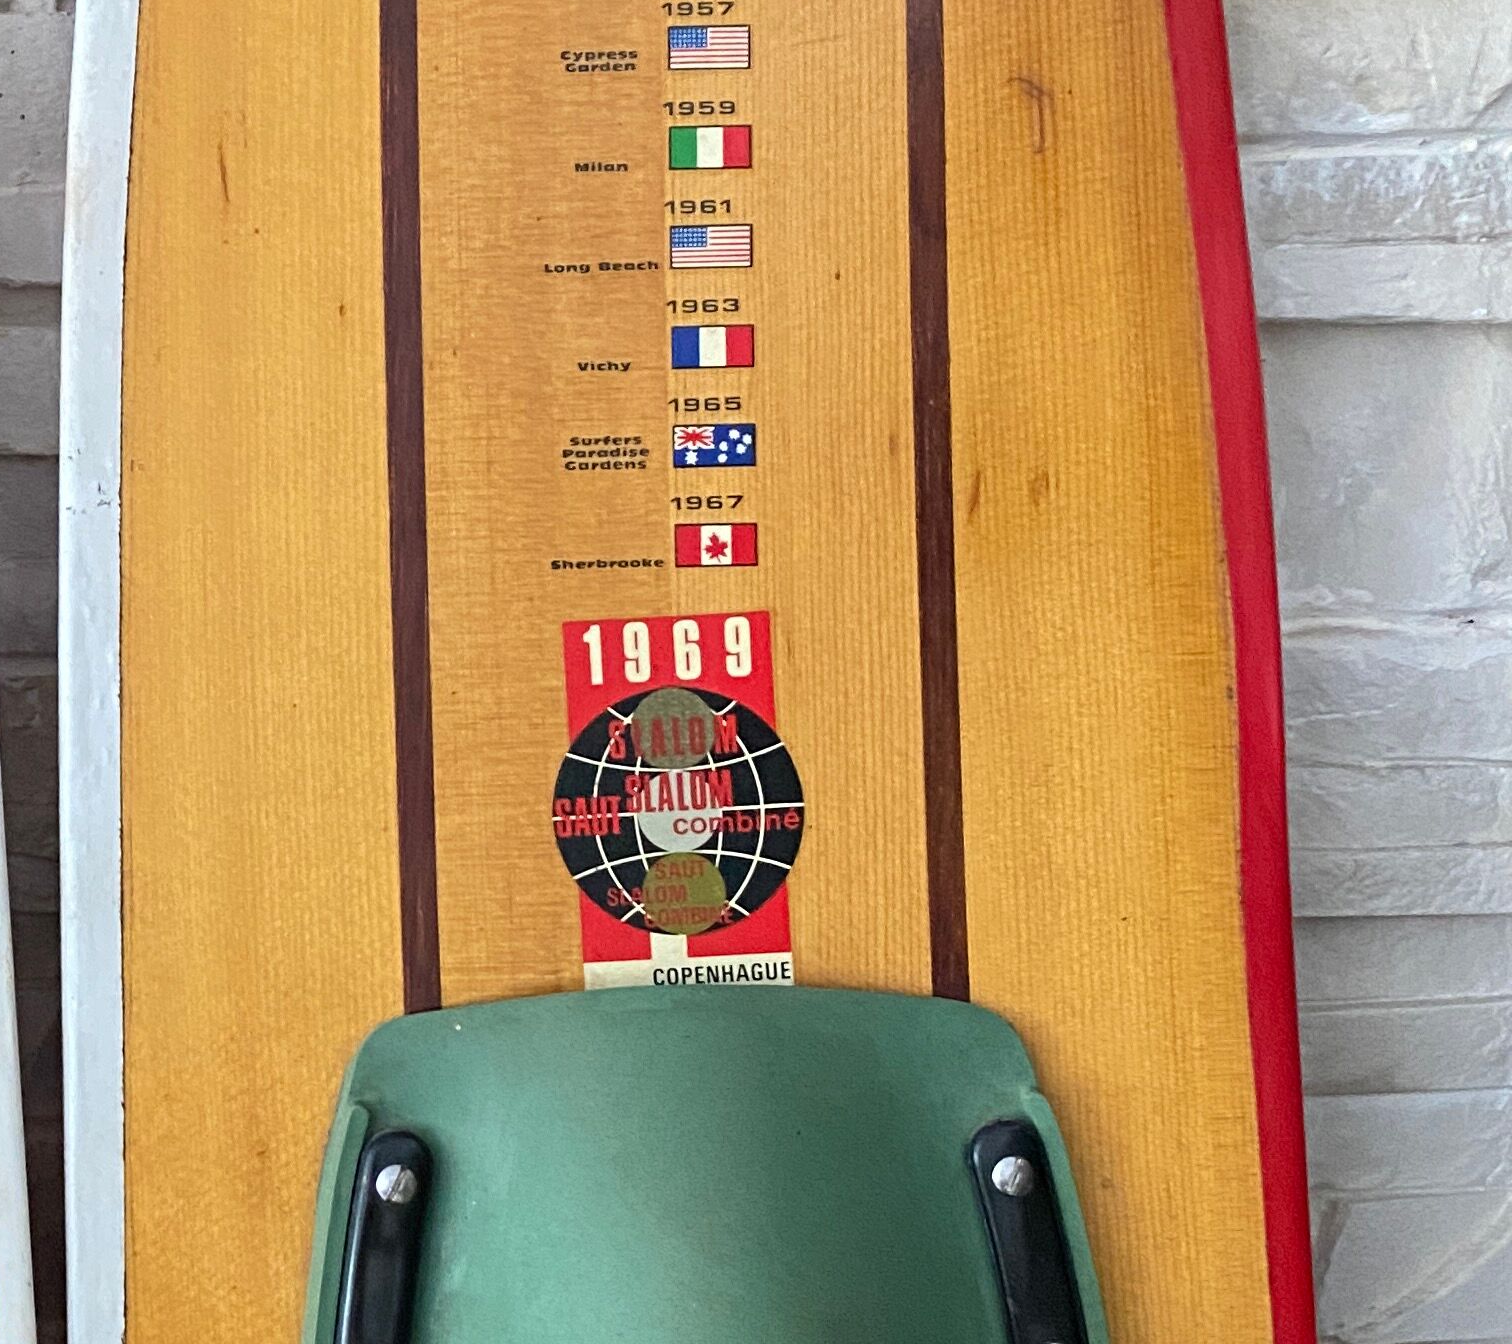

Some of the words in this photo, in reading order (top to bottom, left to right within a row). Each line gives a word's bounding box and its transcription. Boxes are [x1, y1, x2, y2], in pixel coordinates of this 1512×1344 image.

[661, 1, 735, 16] 1957
[560, 49, 638, 61] Cypress
[565, 61, 636, 73] Garden
[663, 101, 736, 116] 1959
[575, 161, 628, 173] Milan
[664, 199, 732, 215] 1961
[544, 262, 590, 273] Long
[598, 260, 659, 271] Beach
[666, 298, 740, 314] 1963
[577, 360, 632, 372] Vichy
[668, 396, 742, 413] 1965
[569, 435, 642, 447] Surfers
[562, 446, 649, 458] Paradise
[564, 458, 647, 471] Gardens
[670, 495, 744, 511] 1967
[550, 557, 665, 570] Sherbrooke
[583, 616, 753, 686] 1969
[608, 714, 738, 760] SLALOM
[624, 769, 733, 814] SLALOM
[554, 795, 621, 838] SAUT
[653, 961, 791, 986] COPENHAGUE
